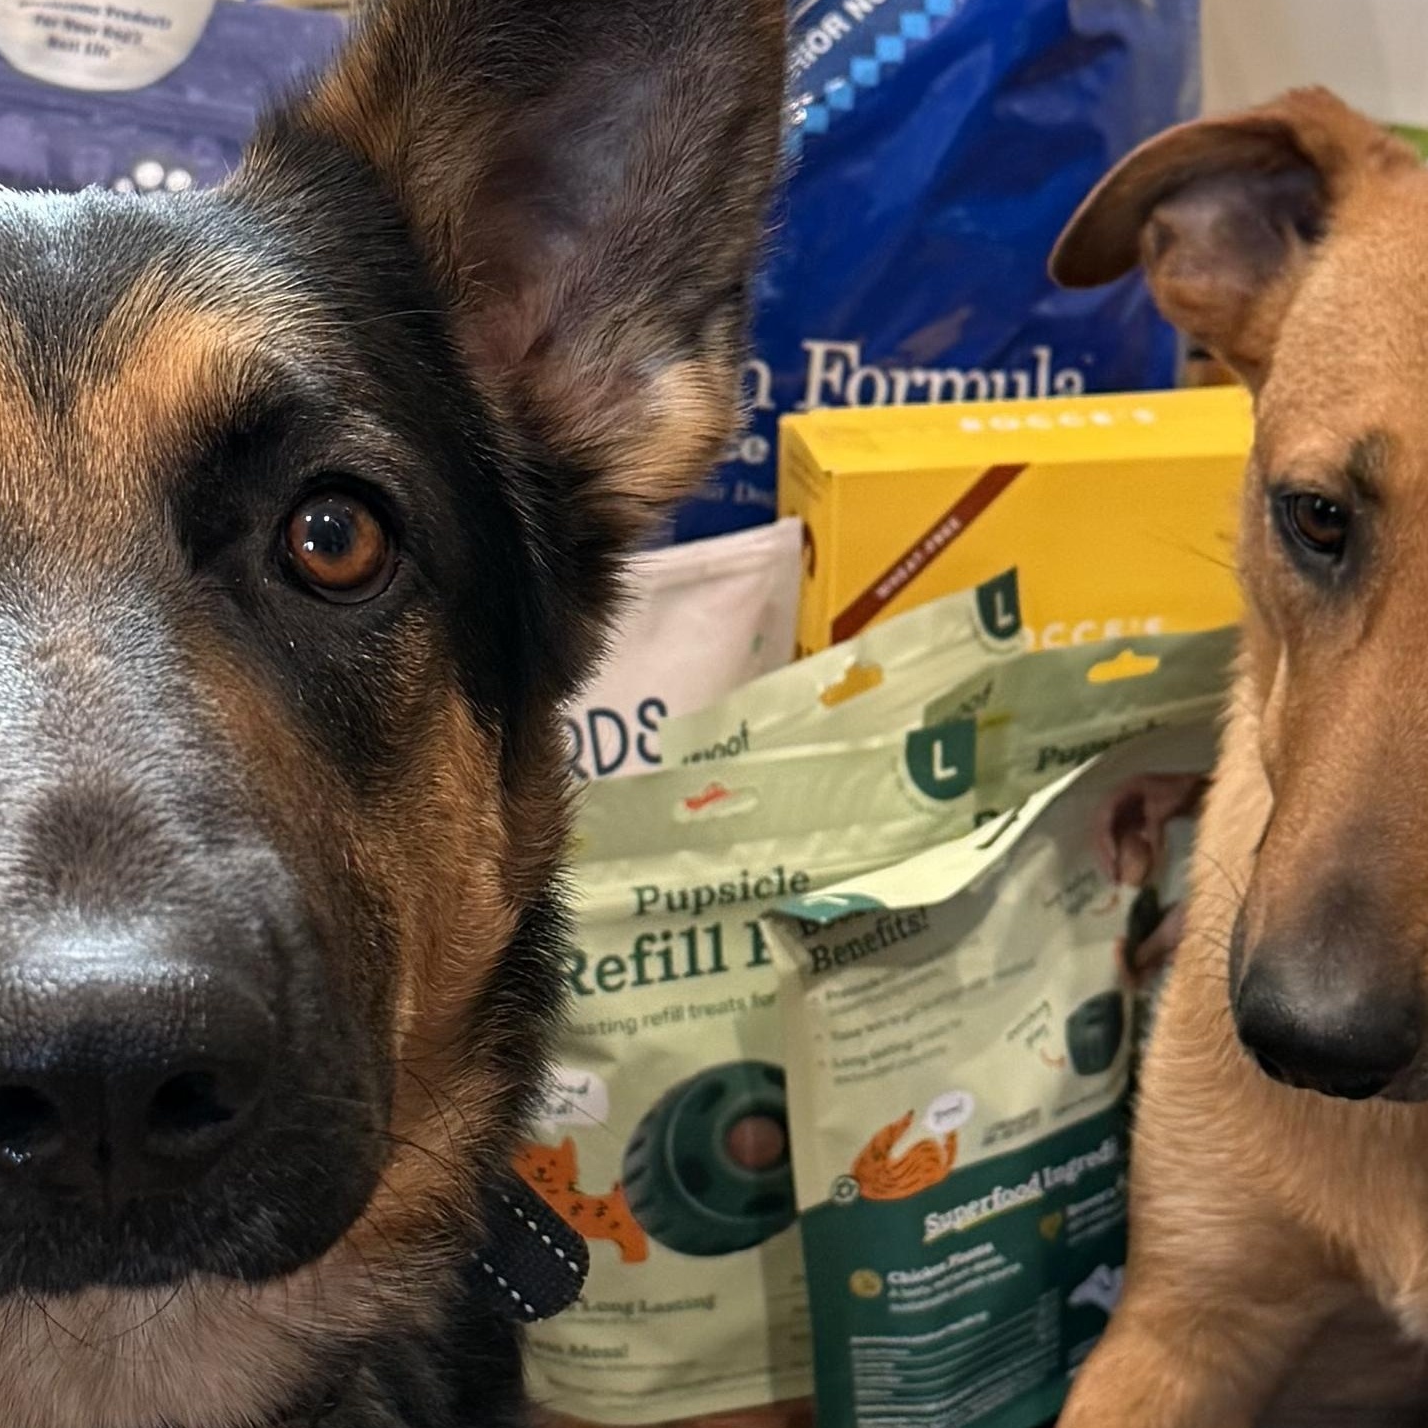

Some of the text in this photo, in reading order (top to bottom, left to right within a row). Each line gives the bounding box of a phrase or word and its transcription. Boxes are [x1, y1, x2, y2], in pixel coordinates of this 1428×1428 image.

[798, 338, 1085, 408] Formula
[633, 866, 811, 916] Pupsicle
[810, 906, 930, 975] Benefits!
[688, 996, 748, 1020] treats
